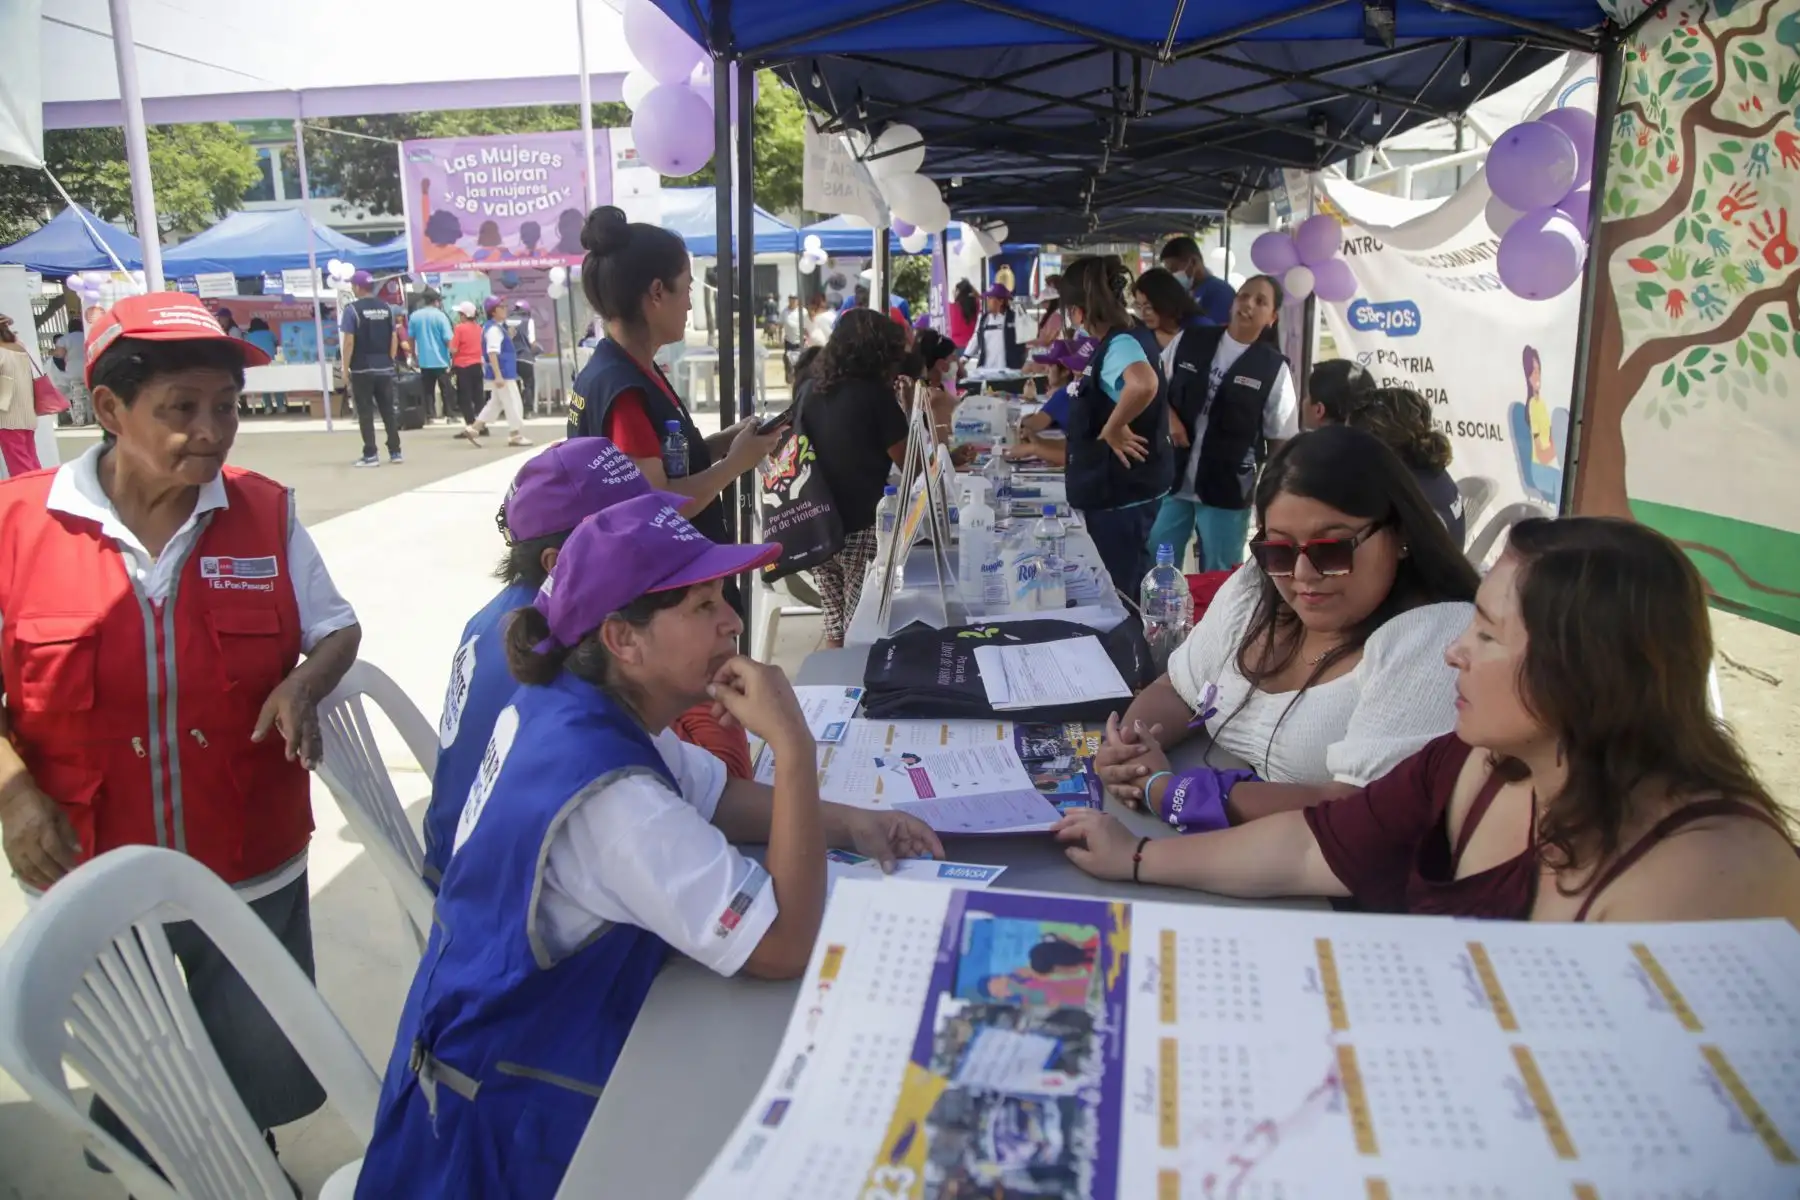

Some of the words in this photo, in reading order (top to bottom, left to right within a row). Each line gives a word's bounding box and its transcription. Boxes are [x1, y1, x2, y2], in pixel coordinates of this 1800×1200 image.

[443, 153, 478, 175] Las
[481, 144, 563, 169] Mujeres
[464, 170, 488, 185] no
[492, 167, 549, 185] lloran
[466, 186, 488, 199] las
[489, 183, 549, 200] mujeres
[455, 194, 480, 214] se
[483, 190, 563, 217] valoran
[1457, 420, 1504, 442] SOCIAL
[587, 455, 605, 470] Las
[602, 460, 615, 471] no
[649, 513, 667, 528] Las
[769, 514, 781, 525] Por
[781, 507, 796, 518] una
[796, 500, 812, 512] vida
[779, 519, 791, 530] de
[944, 867, 988, 879] MINSA
